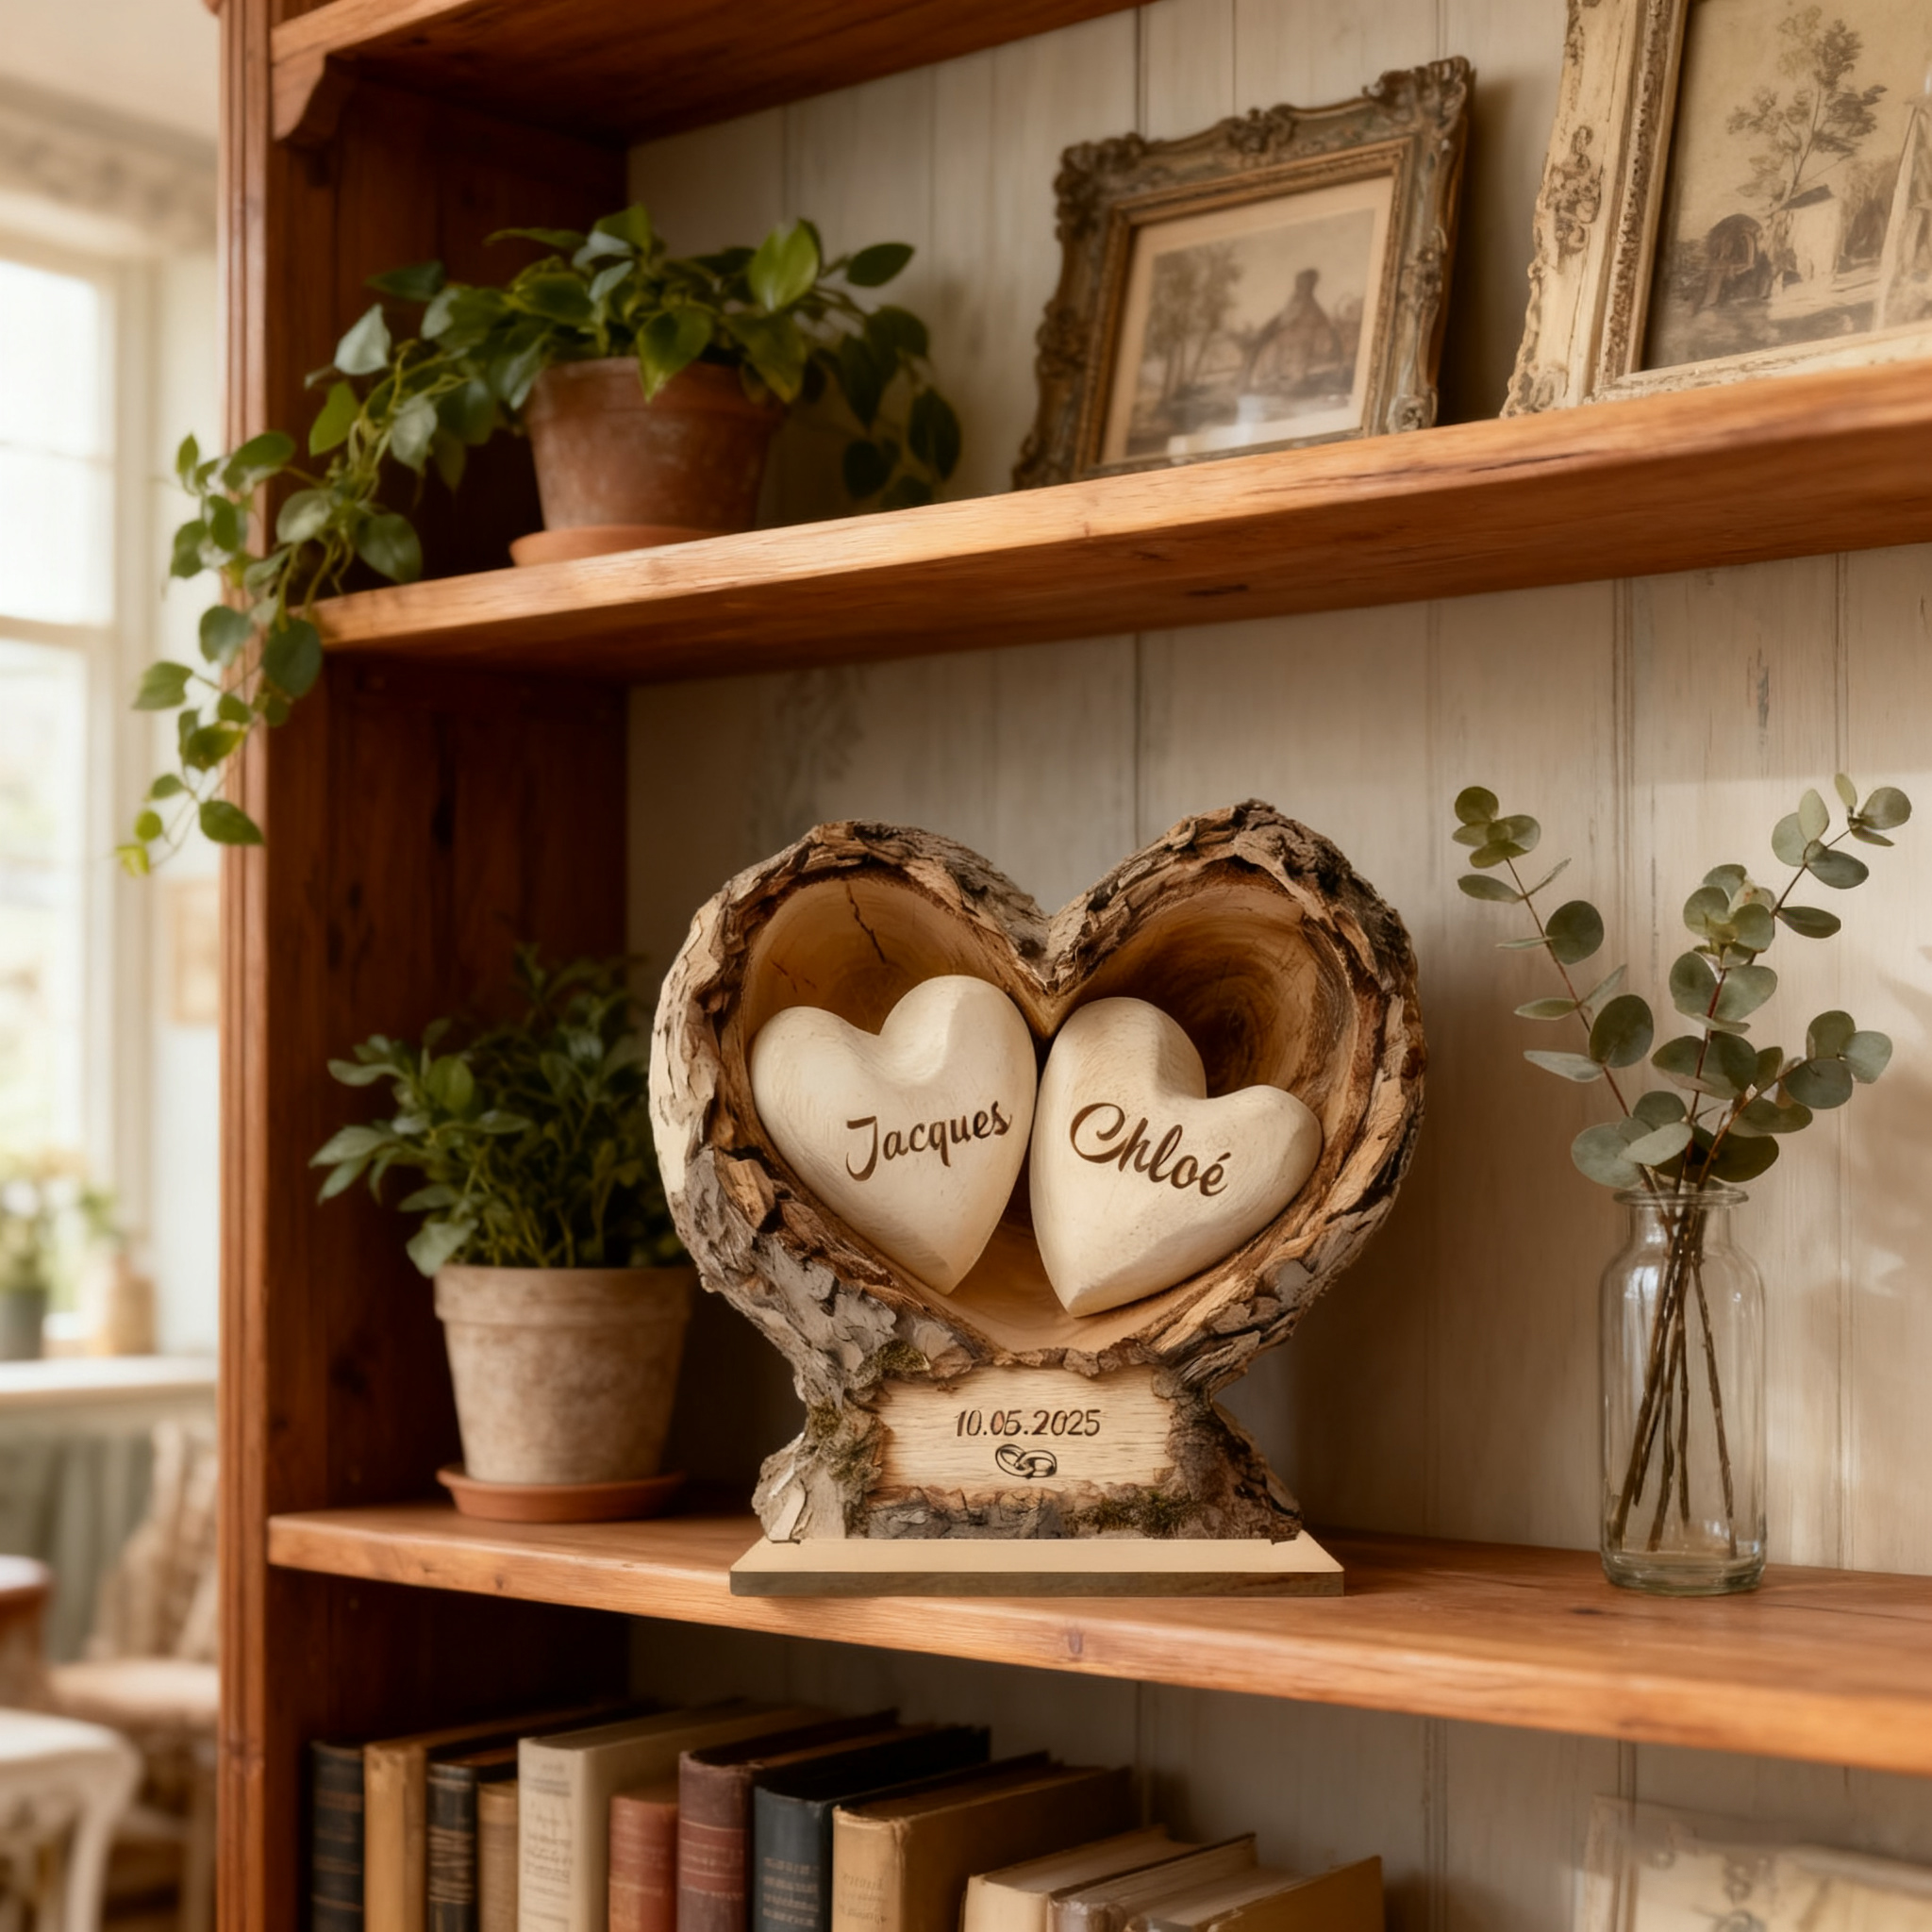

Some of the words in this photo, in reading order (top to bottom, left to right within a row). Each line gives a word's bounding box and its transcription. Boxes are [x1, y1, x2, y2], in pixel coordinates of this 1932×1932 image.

[845, 1100, 1012, 1181] Jacques
[1070, 1102, 1231, 1197] Chloé
[956, 1408, 1102, 1437] 10.05.2025
